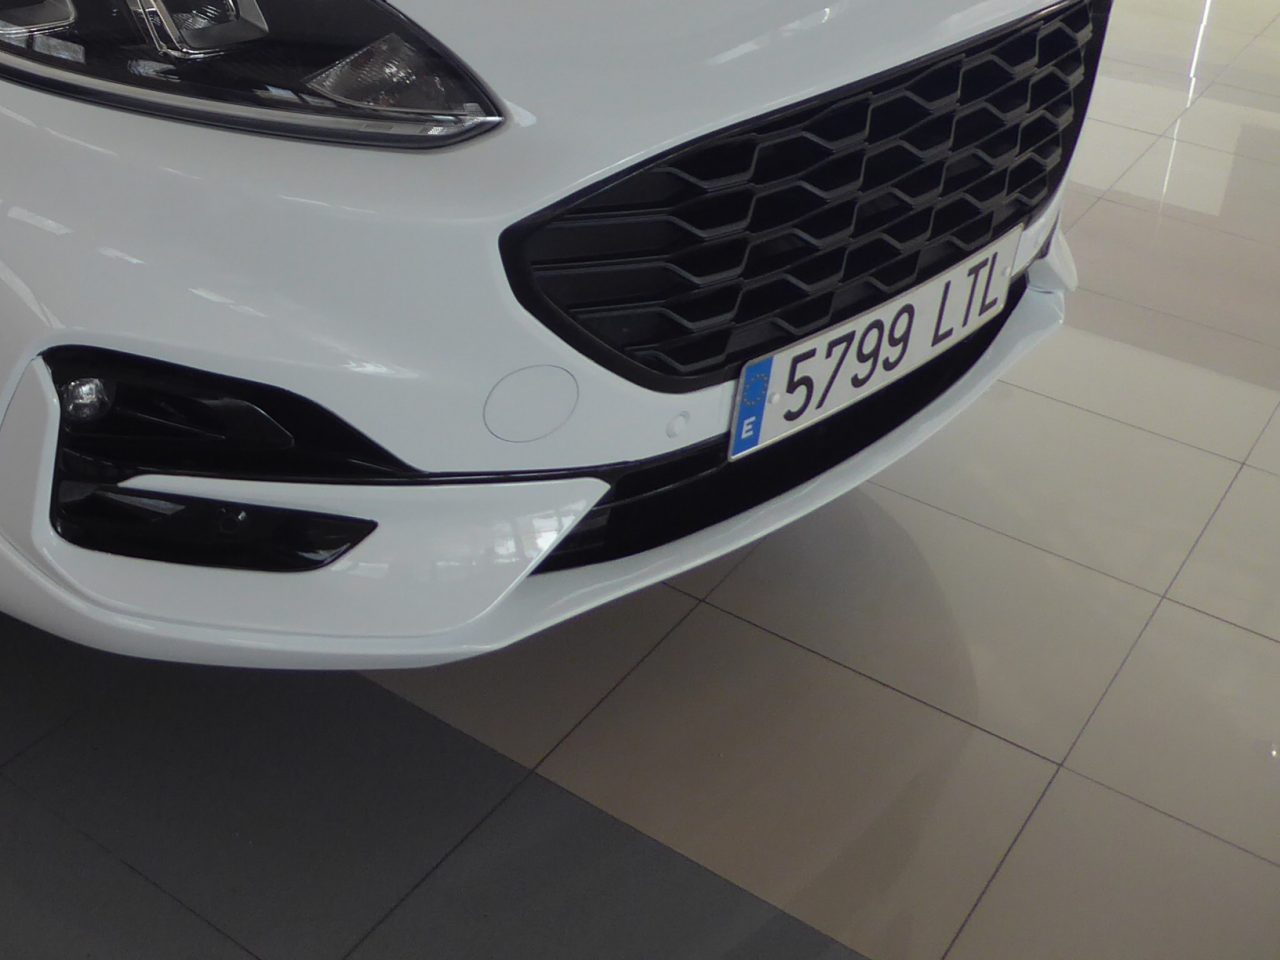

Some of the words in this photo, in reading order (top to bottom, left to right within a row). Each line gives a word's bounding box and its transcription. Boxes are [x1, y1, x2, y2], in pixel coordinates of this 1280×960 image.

[783, 303, 915, 422] 5799
[931, 251, 998, 347] LTL
[741, 416, 756, 440] E
